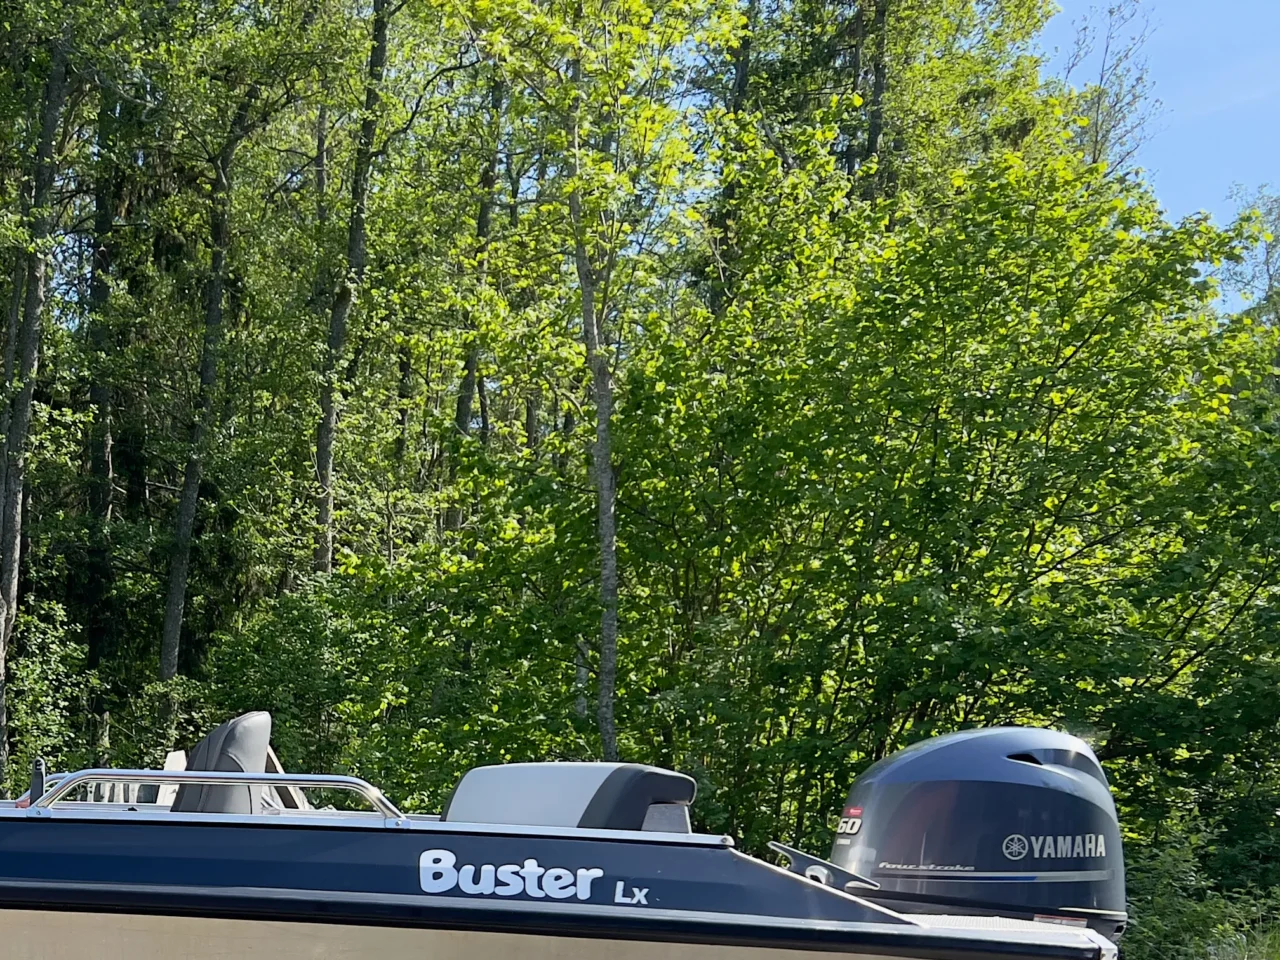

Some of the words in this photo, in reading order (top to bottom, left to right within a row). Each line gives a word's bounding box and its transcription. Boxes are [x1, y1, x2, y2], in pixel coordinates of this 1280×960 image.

[837, 818, 862, 835] 60
[1030, 834, 1106, 858] YAMAHA
[419, 849, 604, 900] Buster
